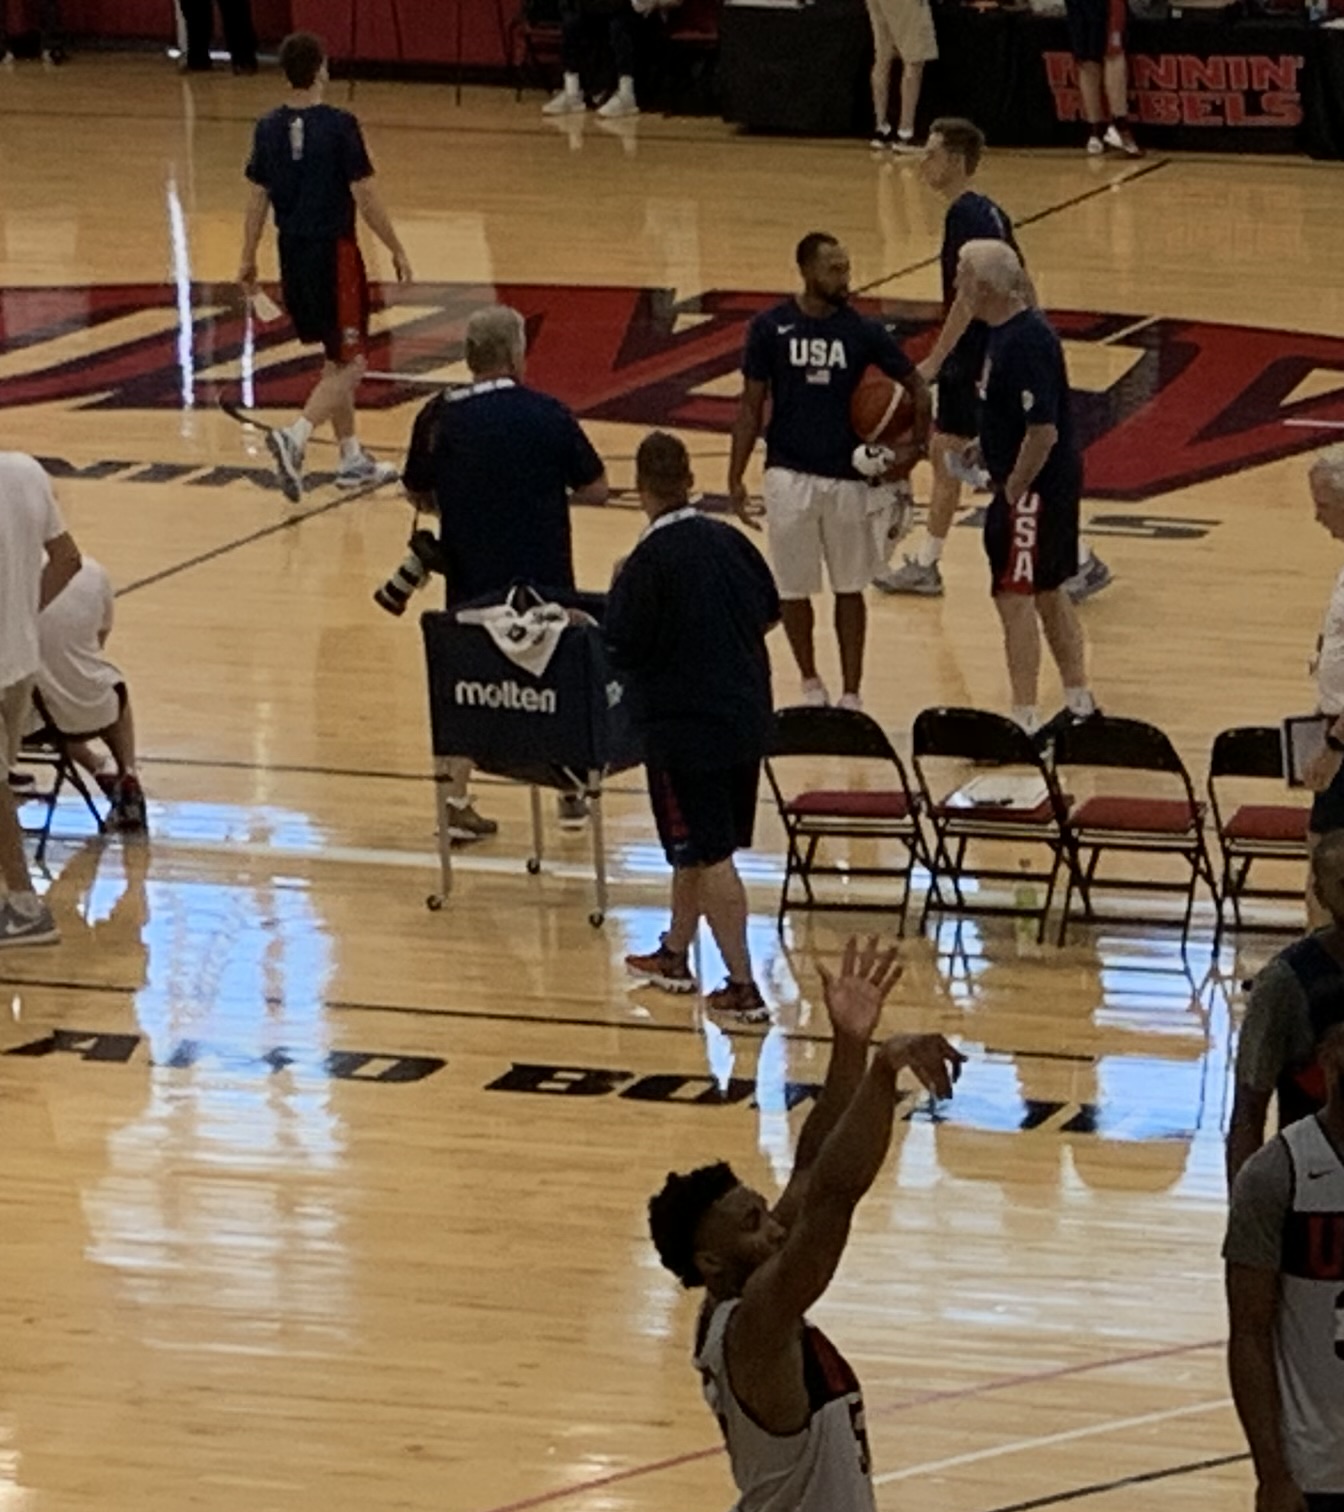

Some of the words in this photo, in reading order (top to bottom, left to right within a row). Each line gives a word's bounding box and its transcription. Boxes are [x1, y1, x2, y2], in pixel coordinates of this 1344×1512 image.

[1043, 51, 1304, 91] RNNIN'
[1053, 89, 1304, 127] RBELS
[789, 338, 848, 369] USA
[1013, 490, 1040, 584] USA
[454, 680, 558, 715] molten
